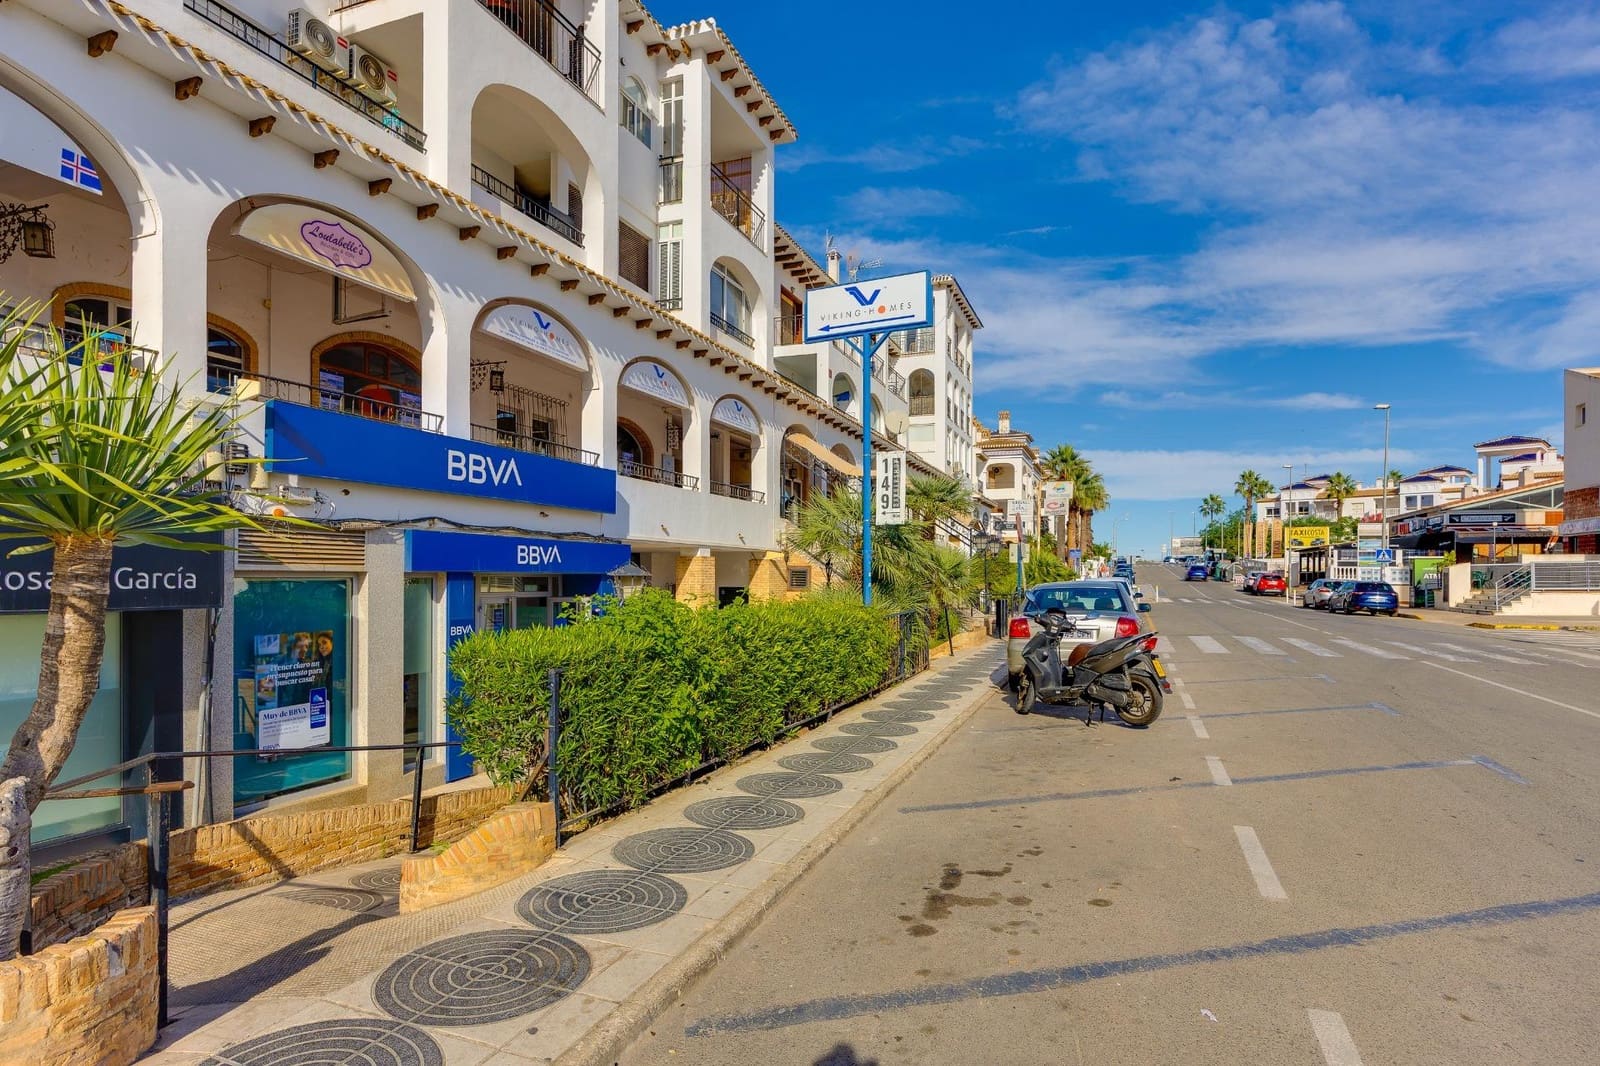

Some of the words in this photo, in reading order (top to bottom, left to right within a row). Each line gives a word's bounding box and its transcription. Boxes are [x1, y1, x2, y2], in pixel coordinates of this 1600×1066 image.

[447, 450, 523, 486] BBVA
[517, 545, 561, 565] BBVA
[0, 570, 54, 590] osa
[114, 566, 197, 590] García
[450, 624, 474, 636] BBVA
[308, 668, 323, 676] para
[263, 712, 278, 721] Muy
[280, 710, 288, 718] de
[289, 707, 307, 716] BBVA
